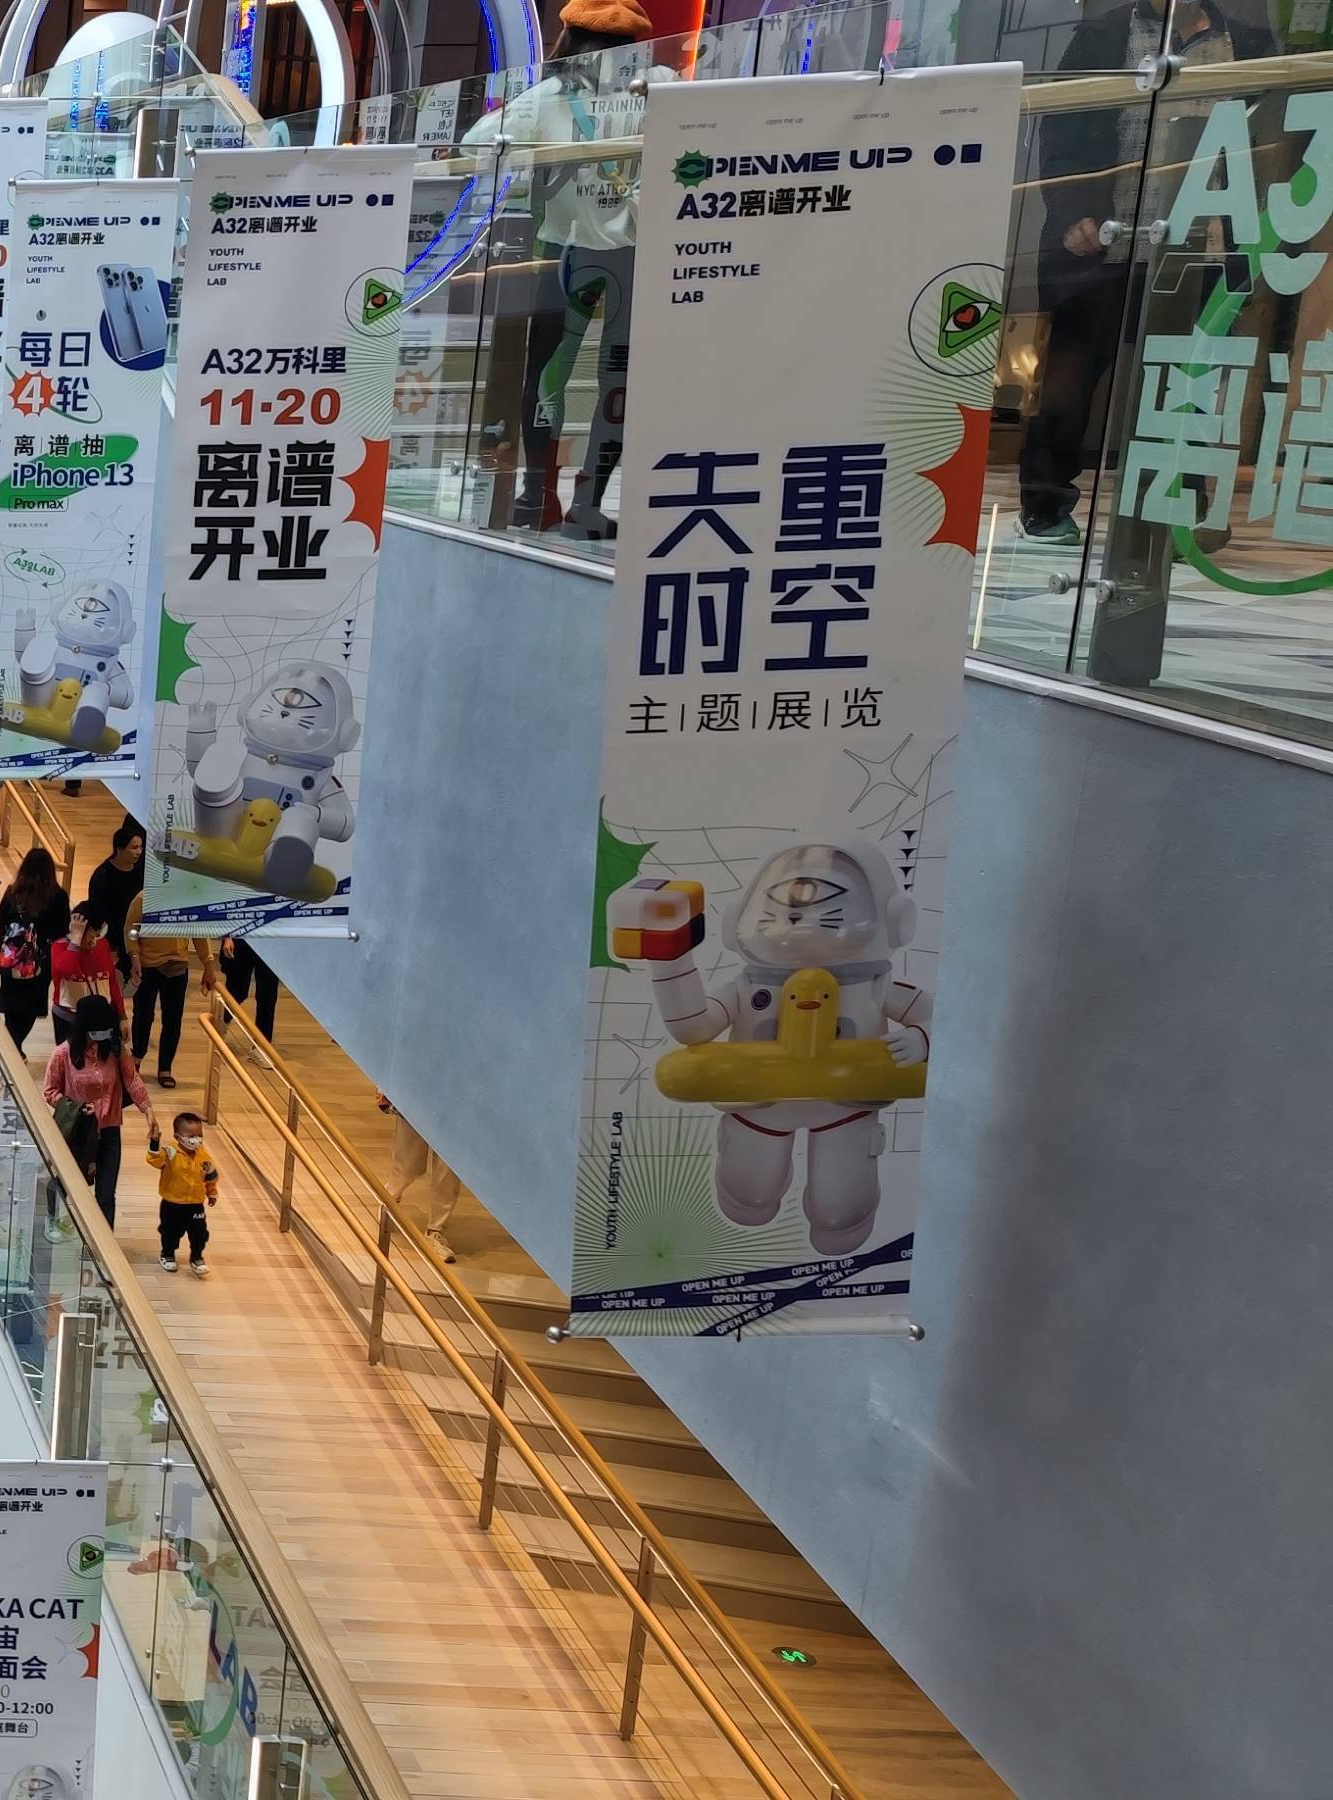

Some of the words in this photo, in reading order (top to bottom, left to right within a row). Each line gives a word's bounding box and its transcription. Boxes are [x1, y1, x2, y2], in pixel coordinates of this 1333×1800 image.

[849, 146, 912, 170] UP
[1169, 93, 1333, 244] A3
[676, 184, 851, 220] A32离谱开业
[211, 215, 318, 235] A32离谱开业
[209, 247, 244, 257] YOUTH
[674, 240, 732, 257] YOUTH
[208, 262, 262, 271] LIFESTYLE
[672, 263, 761, 281] LIFESTYLE
[207, 277, 227, 286] LAB
[671, 290, 704, 305] LAB
[20, 331, 91, 367] 每日
[201, 346, 347, 375] A32万科里
[17, 374, 90, 413] 4轮
[12, 462, 100, 489] iPhone
[105, 462, 134, 487] 13
[193, 440, 336, 508] 离谱
[646, 443, 888, 559] 失重
[189, 515, 329, 581] 开业
[639, 563, 876, 676] 时空
[167, 794, 175, 812] LAB
[611, 1111, 623, 1139] LAB
[607, 1142, 623, 1205] LIFESTYLE
[605, 1206, 617, 1250] YOUTH
[791, 1264, 819, 1276] OPEN
[820, 1261, 837, 1272] ME
[839, 1258, 854, 1269] UP
[601, 1300, 631, 1310] OPEN
[632, 1299, 648, 1308] ME
[650, 1298, 665, 1308] UP
[715, 1317, 741, 1336] OPEN
[742, 1311, 758, 1326] ME
[759, 1301, 774, 1318] UP
